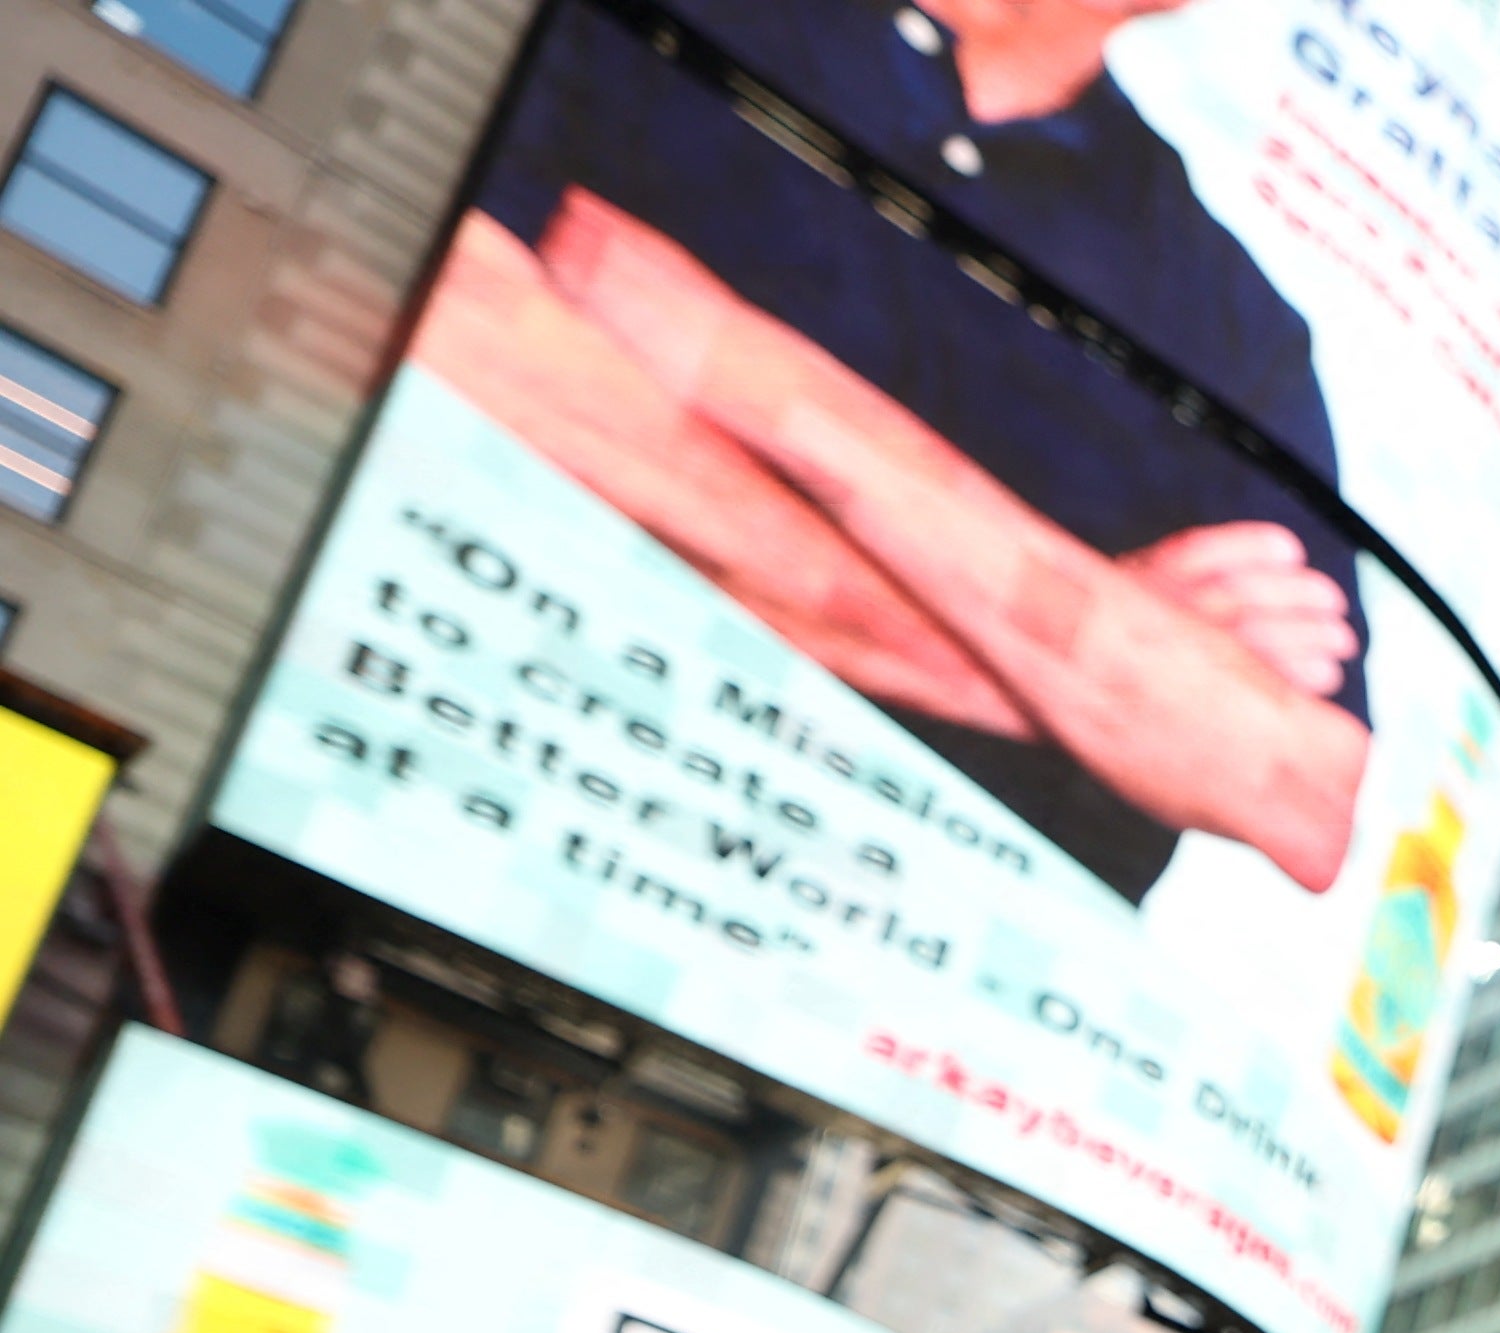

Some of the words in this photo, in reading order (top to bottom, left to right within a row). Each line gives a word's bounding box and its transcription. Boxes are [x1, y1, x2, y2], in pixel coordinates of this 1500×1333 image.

[312, 714, 420, 781] at
[460, 790, 512, 832] a
[375, 574, 472, 652] to
[855, 838, 900, 876] a
[620, 641, 671, 682] a
[712, 677, 1034, 877] Mission
[344, 636, 670, 826] Better
[703, 818, 954, 971] World
[1030, 989, 1167, 1086] One
[1191, 1077, 1329, 1196] Drink
